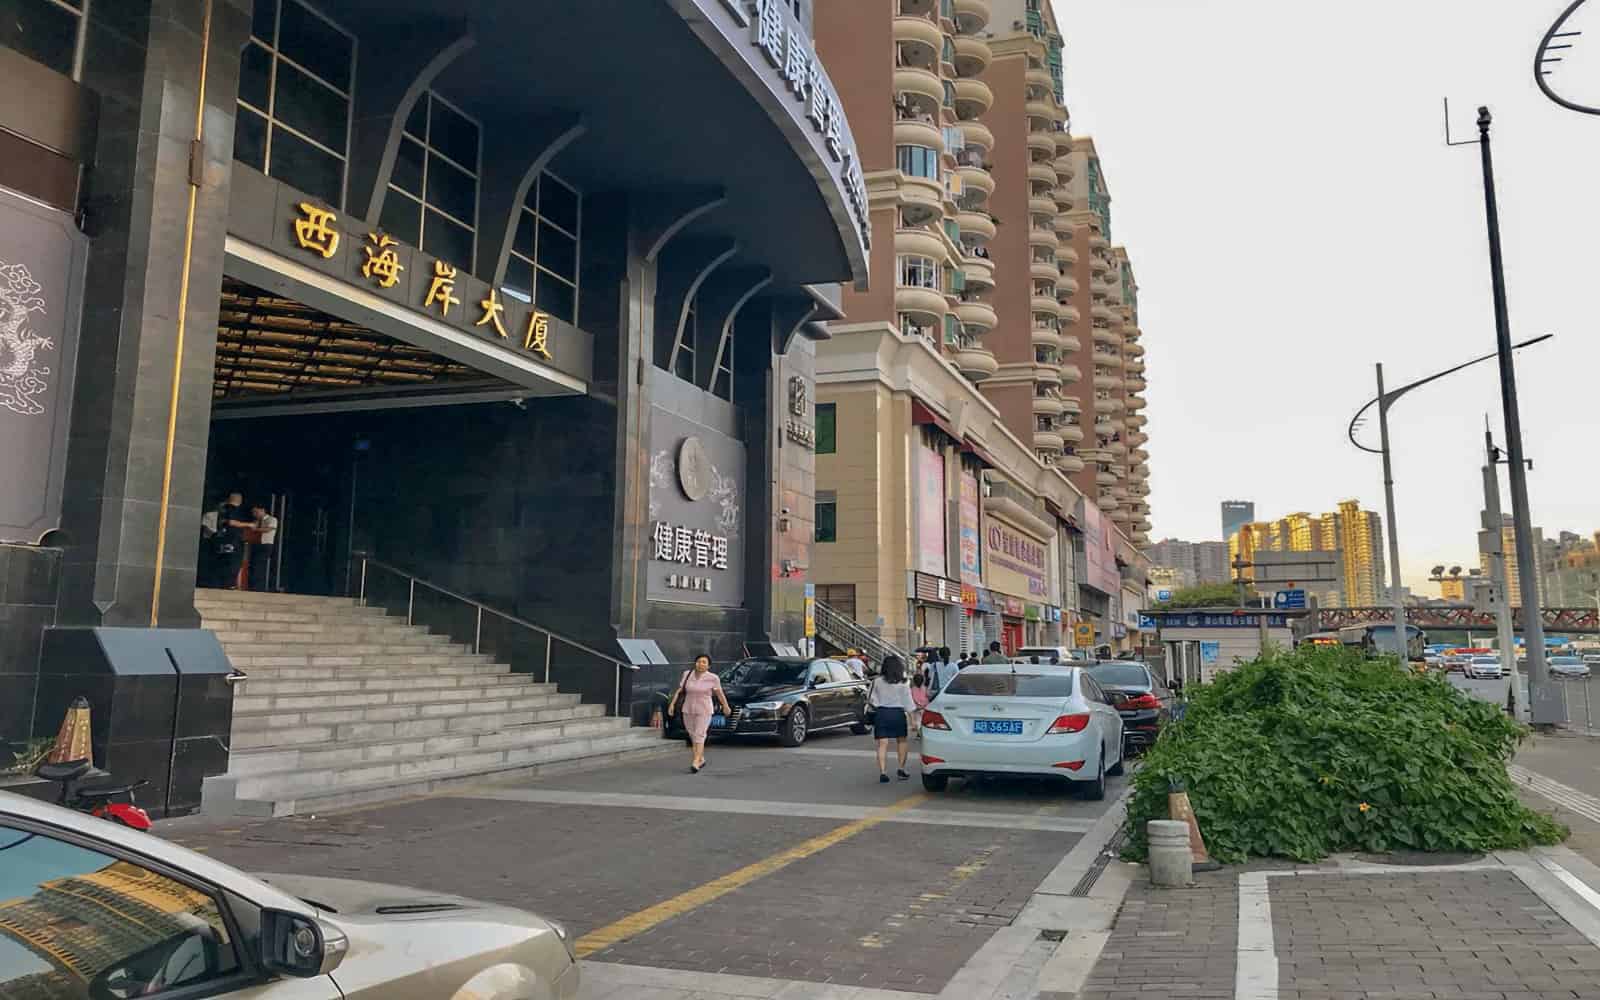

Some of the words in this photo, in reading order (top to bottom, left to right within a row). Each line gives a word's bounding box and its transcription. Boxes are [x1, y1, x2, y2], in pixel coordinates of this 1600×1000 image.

[295, 202, 552, 360] 西海岸大厦
[653, 521, 728, 570] 健康管理
